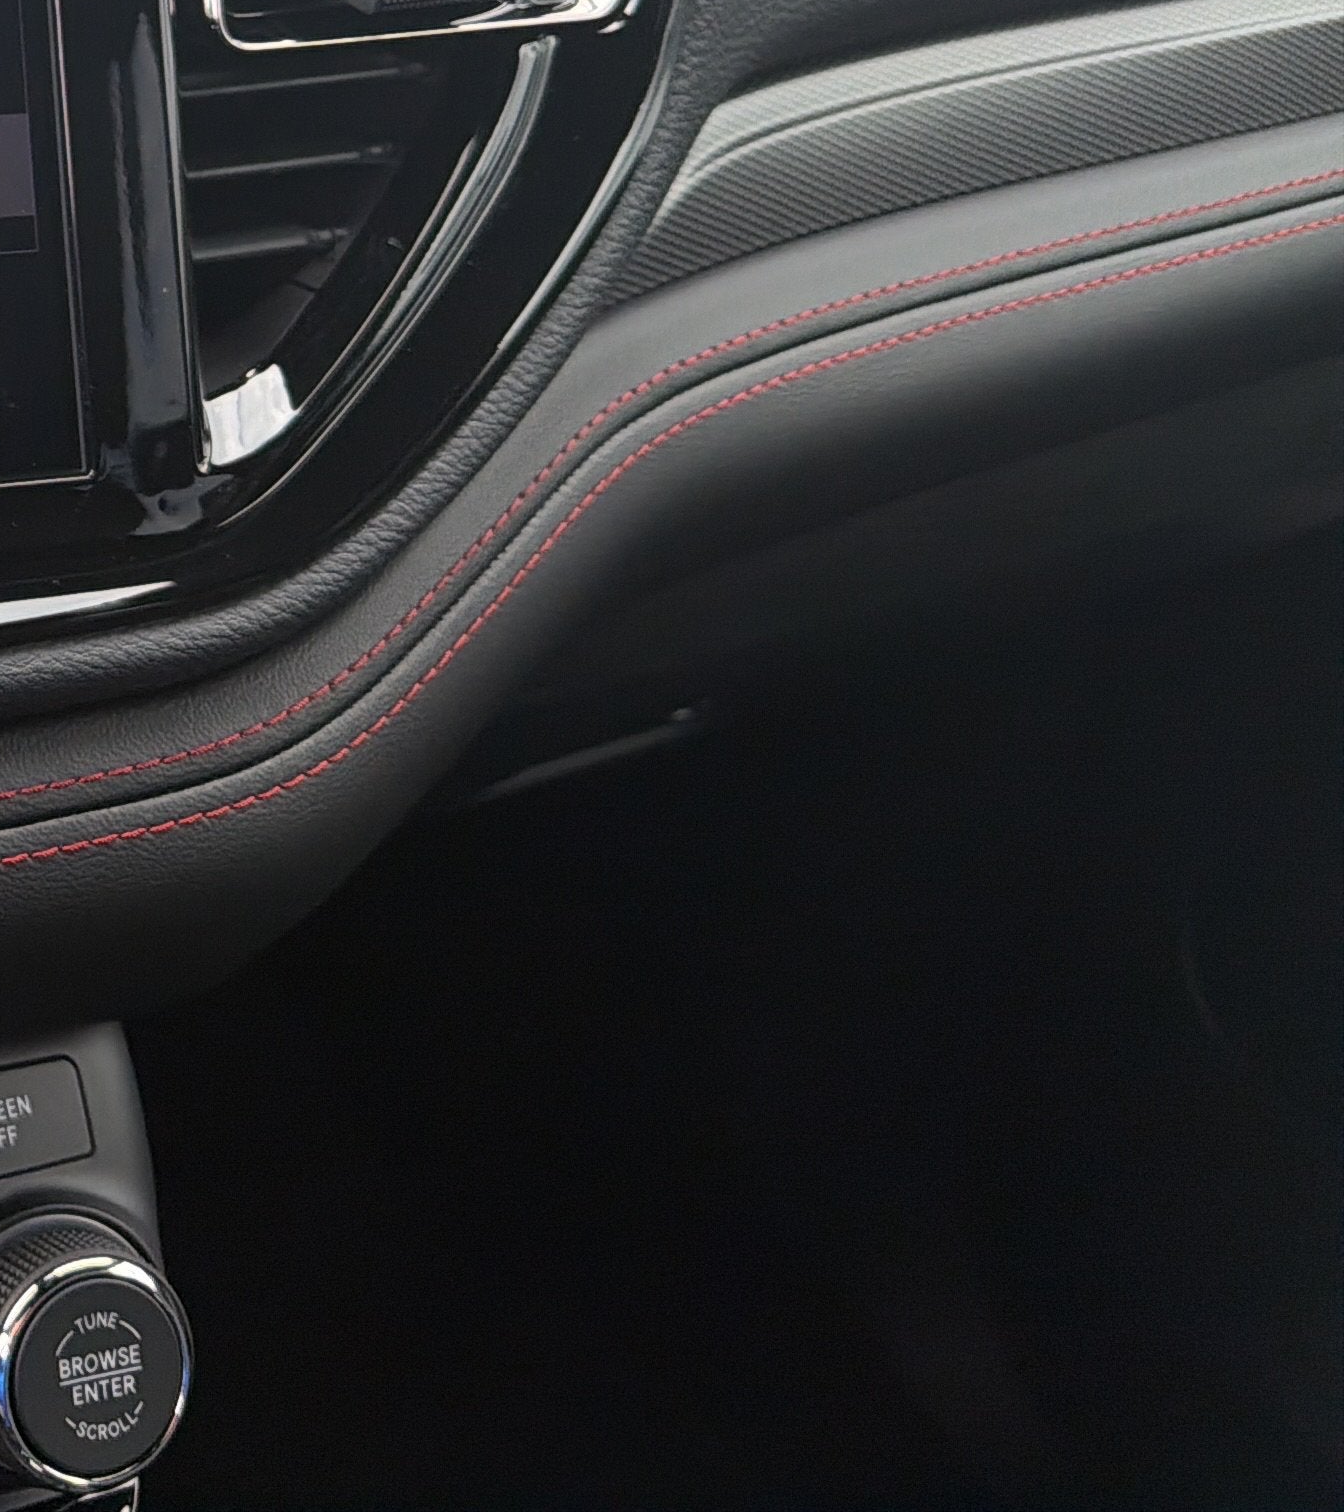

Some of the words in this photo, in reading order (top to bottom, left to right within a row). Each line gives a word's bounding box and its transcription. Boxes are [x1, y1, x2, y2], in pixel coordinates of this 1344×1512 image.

[73, 1311, 120, 1336] TUNE
[58, 1343, 142, 1379] BROWSE
[71, 1375, 137, 1406] ENTER
[74, 1410, 138, 1443] SCROLL
